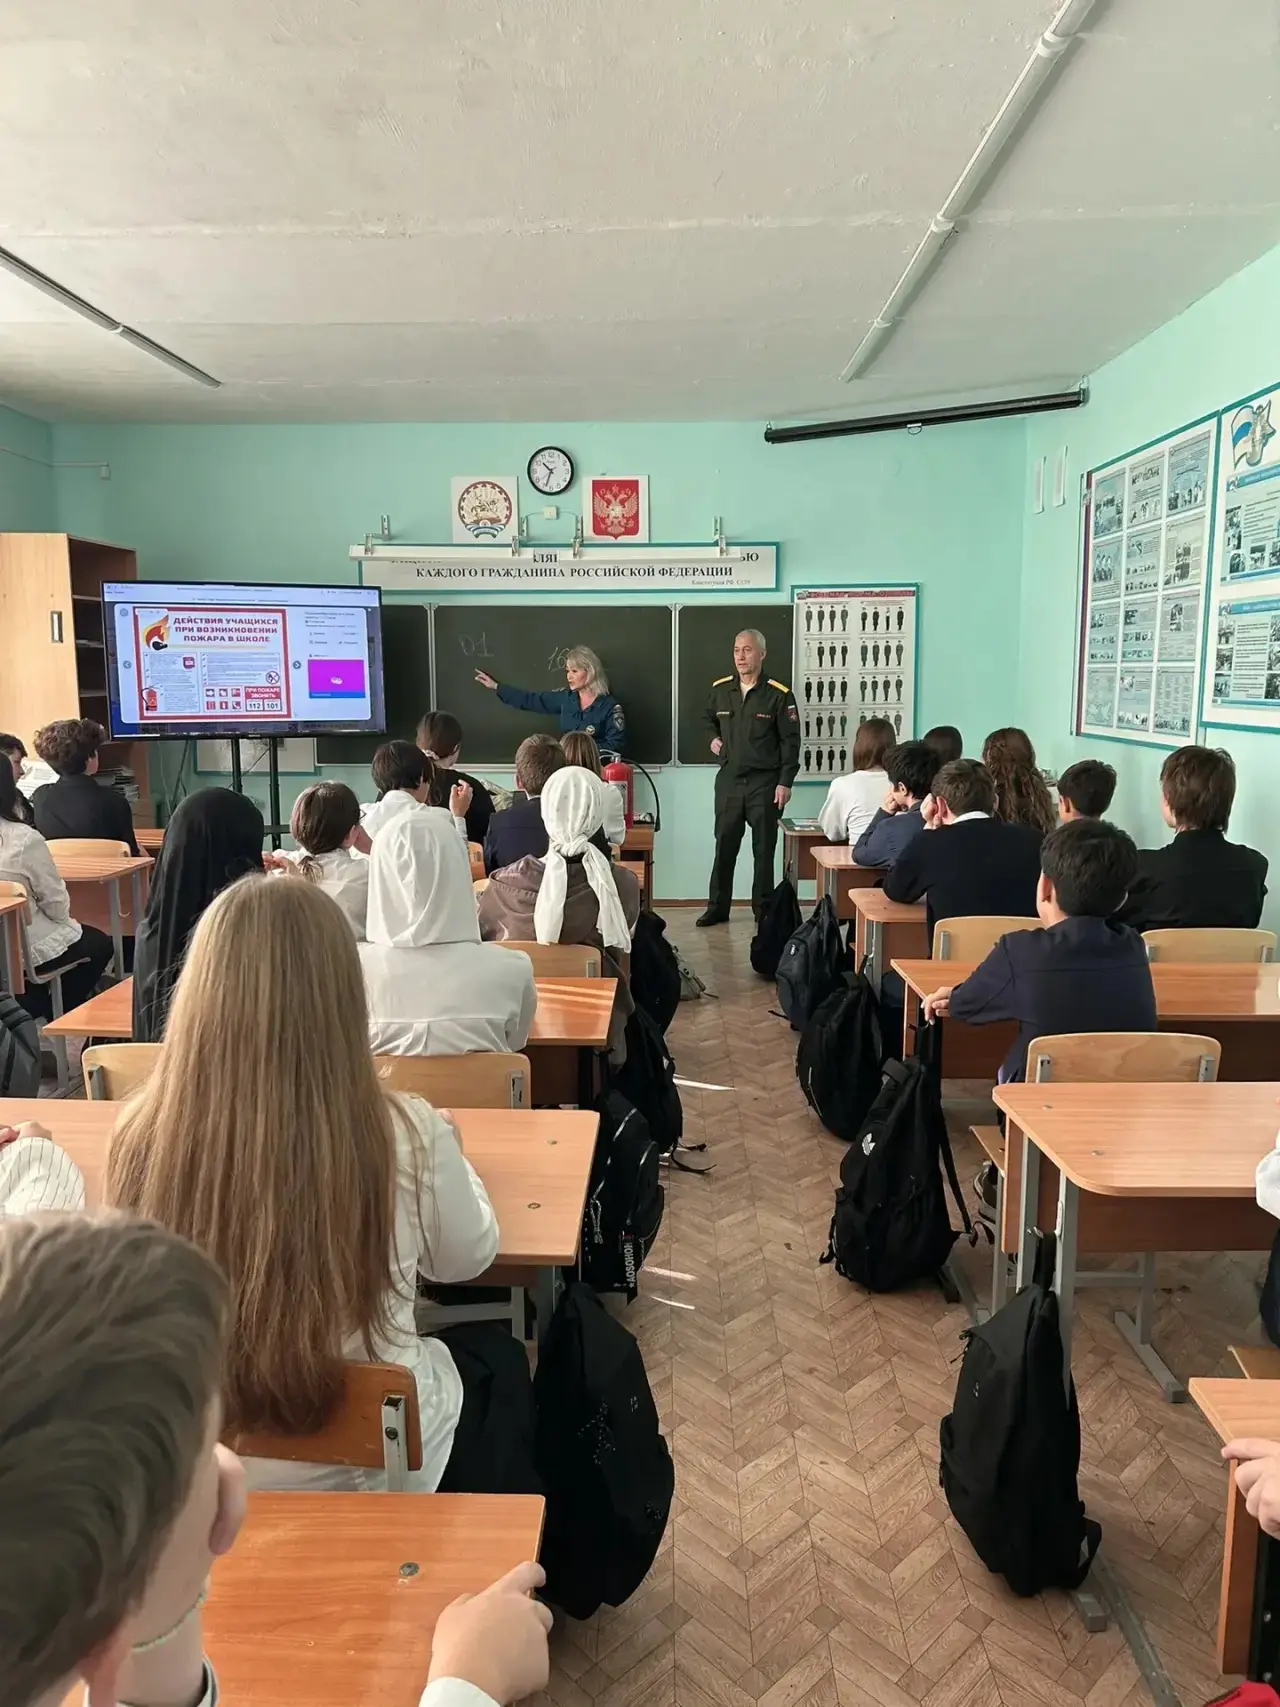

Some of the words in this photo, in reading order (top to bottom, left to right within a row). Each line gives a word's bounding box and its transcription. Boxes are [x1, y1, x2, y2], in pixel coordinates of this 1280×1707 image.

[416, 568, 478, 578] КАЖДОГО
[481, 567, 566, 578] ГРАЖДАНИНА
[570, 566, 655, 577] РОССИЙСКОЙ
[658, 567, 733, 578] ФЕДЕРАЦИИ
[173, 616, 223, 625] ДЕЙСТВИЯ
